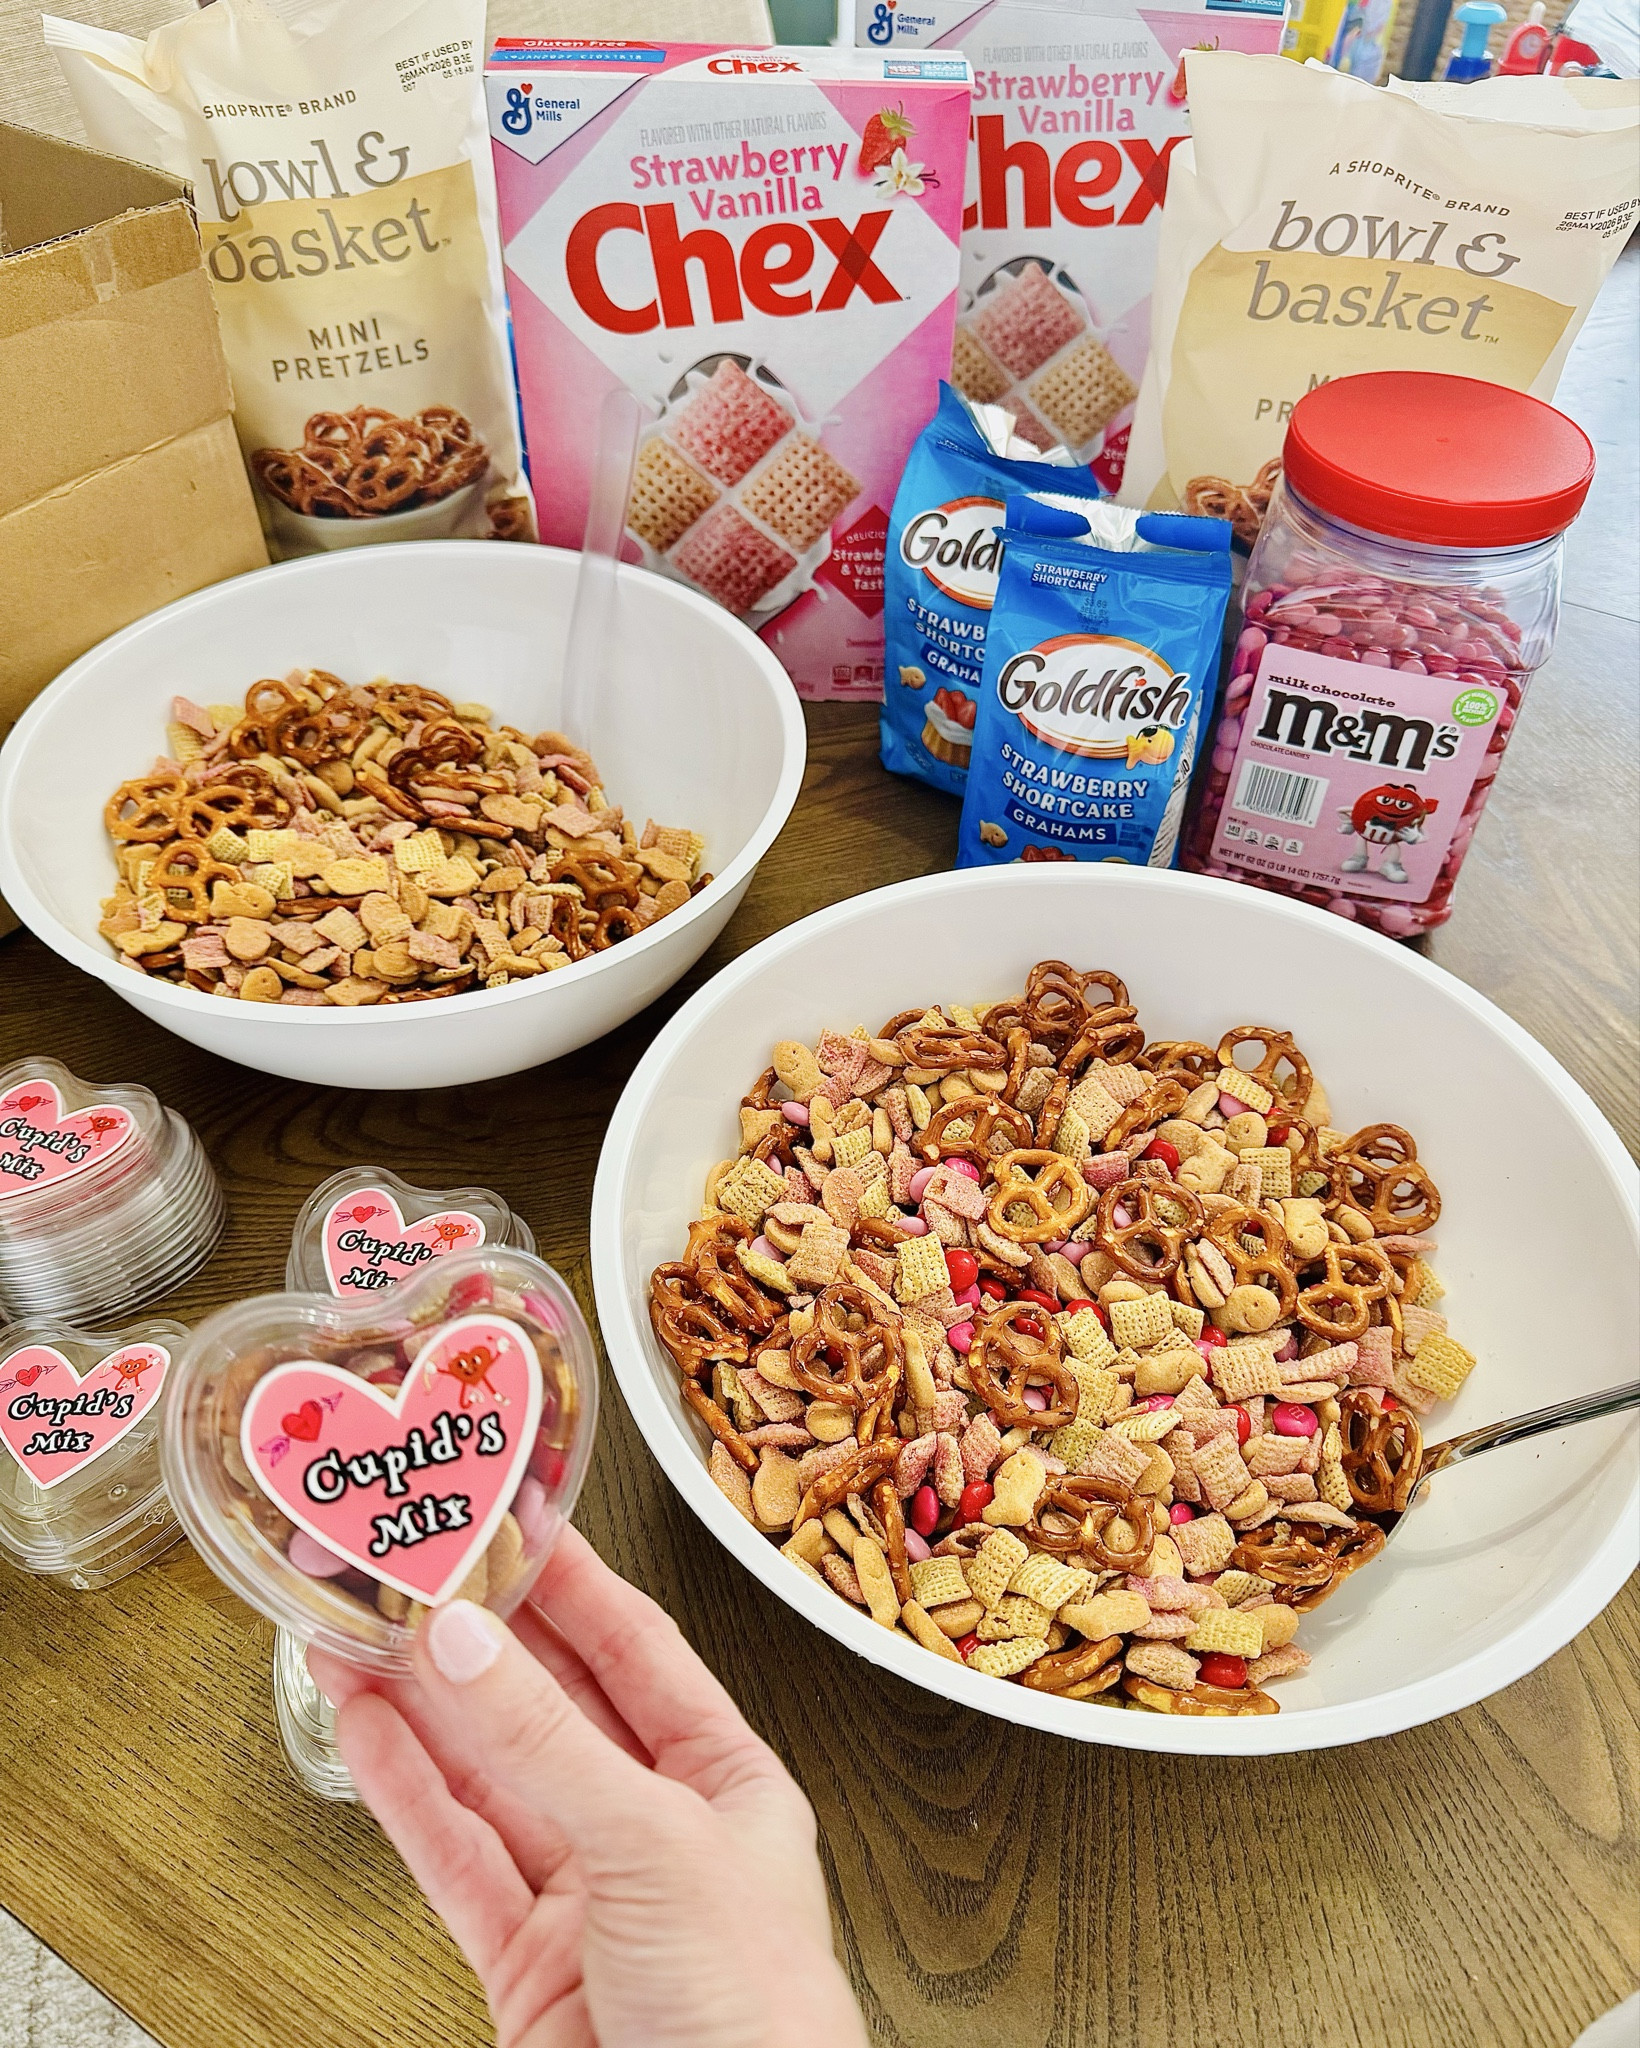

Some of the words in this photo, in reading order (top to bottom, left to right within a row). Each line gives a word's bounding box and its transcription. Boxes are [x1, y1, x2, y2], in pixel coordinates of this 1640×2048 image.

[897, 13, 936, 26] General
[897, 24, 919, 35] Mills
[395, 55, 420, 71] BEST
[421, 51, 430, 61] IF
[432, 42, 460, 58] USED
[461, 39, 473, 50] BY
[707, 58, 804, 75] Chex
[298, 89, 357, 115] BRAND
[971, 64, 1166, 106] Strawberry
[535, 98, 580, 110] General
[535, 110, 562, 122] Mills
[1018, 99, 1136, 134] Vanilla
[640, 125, 686, 148] FLAVORED
[686, 122, 713, 143] WITH
[713, 119, 742, 141] OTHER
[743, 114, 786, 137] NATURAL
[787, 110, 827, 133] FLAVORS
[355, 130, 410, 188] &
[630, 140, 849, 191] Strawberry
[963, 114, 1192, 231] hex
[689, 176, 824, 222] Vanilla
[1329, 162, 1341, 176] A
[1444, 199, 1511, 217] BRAND
[1564, 210, 1595, 220] BEST
[1596, 208, 1606, 219] IF
[1607, 201, 1630, 217] USED
[1268, 200, 1449, 266] bowl
[1456, 232, 1521, 278] &
[566, 201, 904, 335] Chex
[308, 317, 382, 352] MINI
[272, 337, 430, 383] PRETZELS
[832, 547, 885, 561] Strawb
[846, 530, 886, 544] DELICIO
[903, 512, 1004, 576] Gold
[853, 578, 884, 591] Tast
[1031, 573, 1097, 592] SHORTCAKE
[1033, 562, 1108, 583] STRAWBERRY
[907, 597, 986, 642] STRAWB
[914, 621, 985, 662] SHORTC
[926, 650, 980, 683] GRAHA
[1000, 653, 1190, 726] Goldfish
[1267, 674, 1310, 691] milk
[1311, 683, 1396, 708] chocolate
[1250, 739, 1285, 755] CHOCOLATE
[1285, 748, 1311, 760] CANDIES
[1000, 743, 1148, 798] STRAWBERRY
[1002, 771, 1134, 819] SHORTCAKE
[1012, 808, 1107, 841] GRAHAMS
[1219, 847, 1232, 857] NET
[1234, 851, 1246, 861] WT
[1256, 858, 1266, 867] OZ
[0, 1117, 91, 1163] Cupid's
[0, 1152, 45, 1180] Mix
[337, 1229, 443, 1267] Cupid'
[7, 1388, 134, 1430] Cupid's
[23, 1429, 95, 1458] Mix
[302, 1410, 507, 1505] Cupid's
[366, 1491, 475, 1558] Mix
